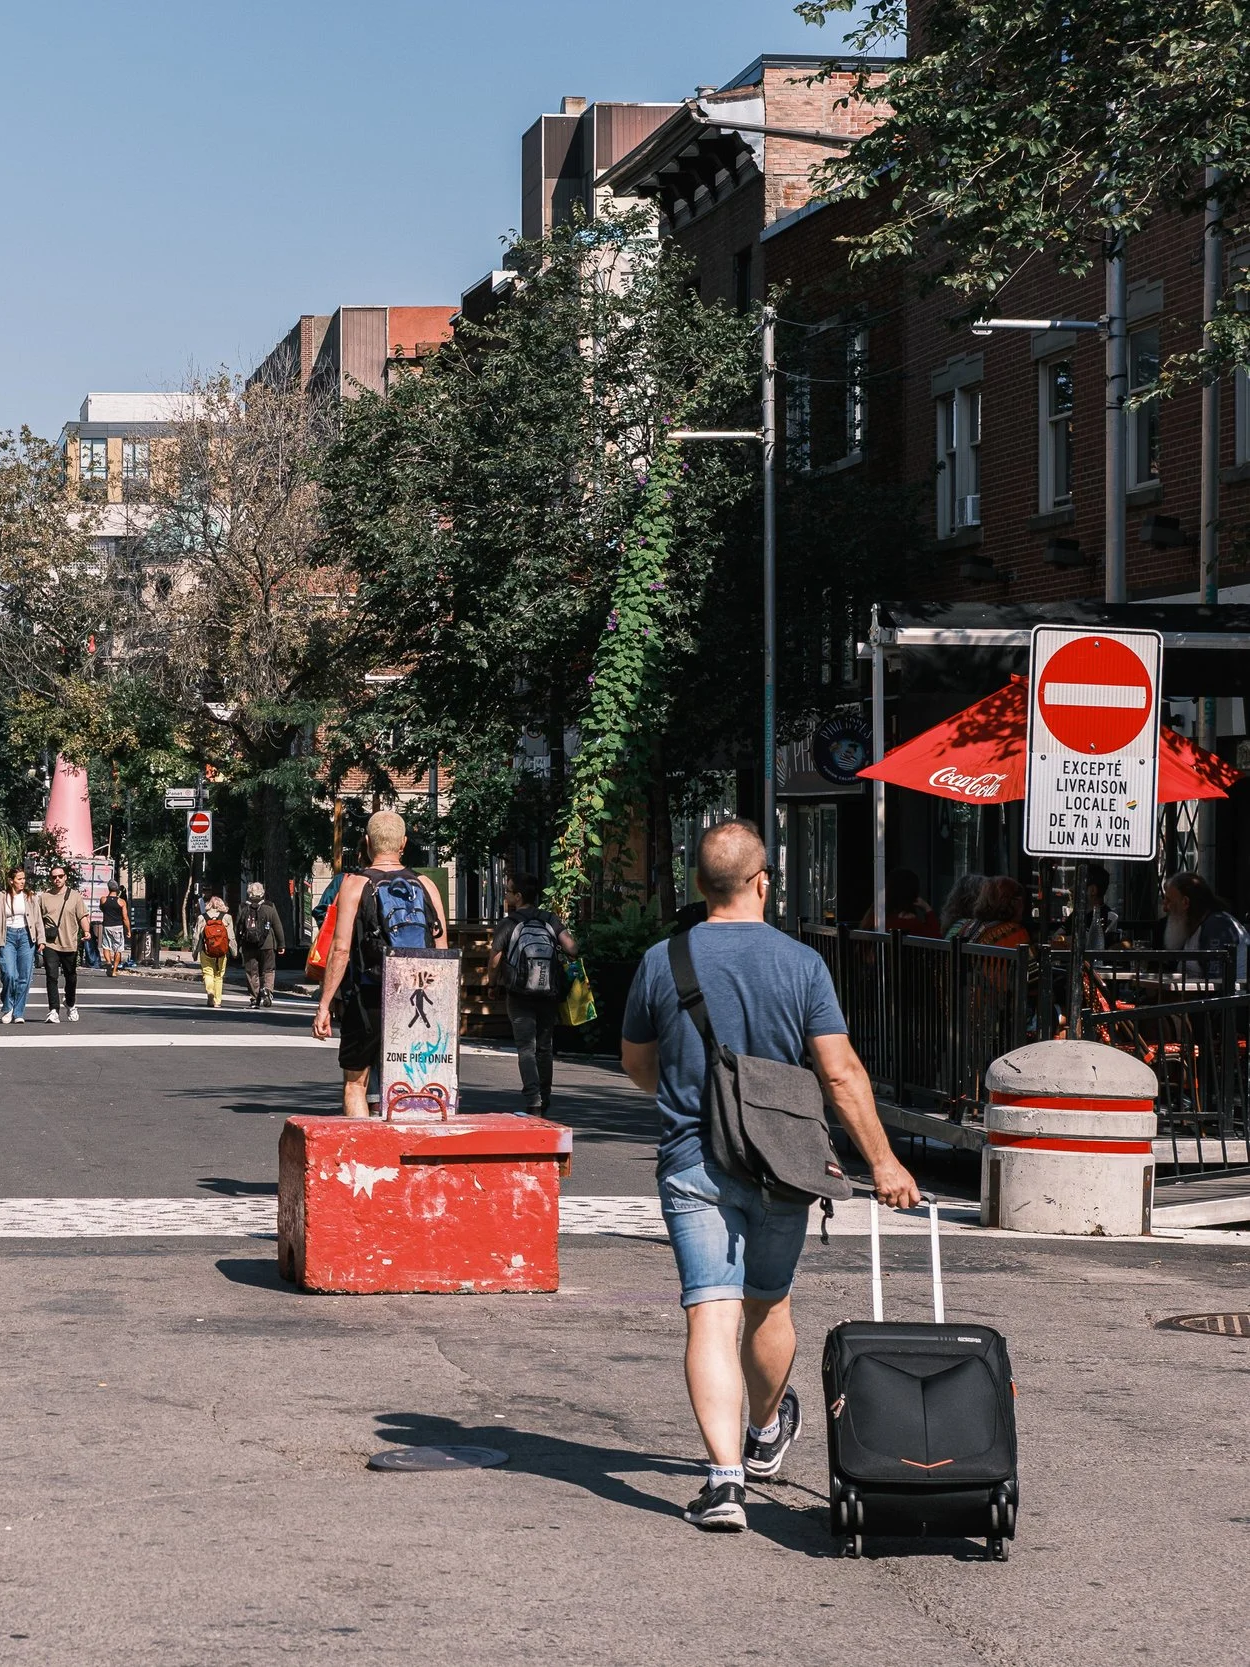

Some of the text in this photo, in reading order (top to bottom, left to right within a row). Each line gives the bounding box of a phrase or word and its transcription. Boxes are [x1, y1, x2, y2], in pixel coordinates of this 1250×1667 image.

[1063, 760, 1122, 777] EXCEPTÉ
[929, 767, 1009, 797] Coca-Cola
[1056, 778, 1127, 795] LIVRAISON
[1065, 796, 1117, 812] LOCALE
[1049, 813, 1130, 830] DE 7h À 10h
[1049, 831, 1131, 848] LUN AU VEN
[386, 1052, 408, 1063] ZONE
